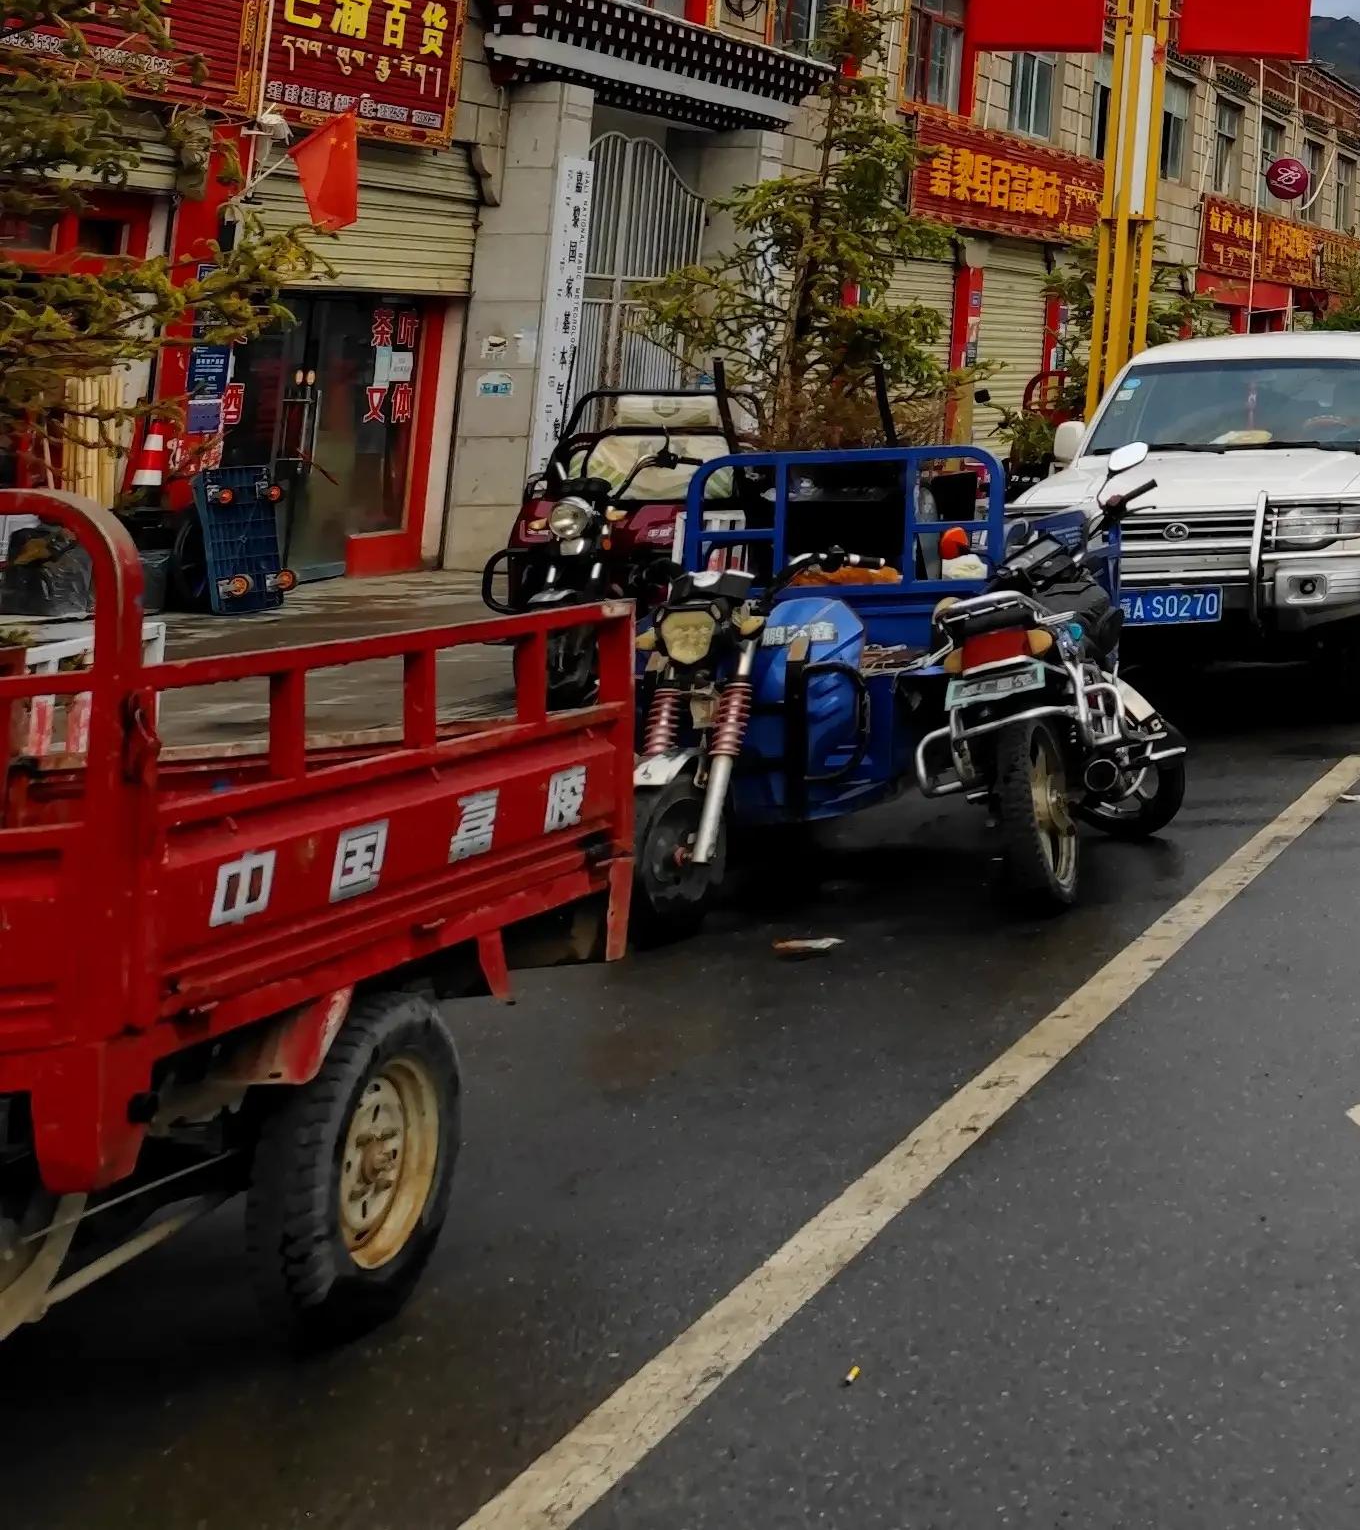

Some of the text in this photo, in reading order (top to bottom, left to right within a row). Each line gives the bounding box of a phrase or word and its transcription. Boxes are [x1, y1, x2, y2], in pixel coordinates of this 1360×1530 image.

[579, 200, 589, 244] NATIONAL
[371, 308, 418, 348] 茶叶
[209, 765, 588, 928] 中国嘉陵
